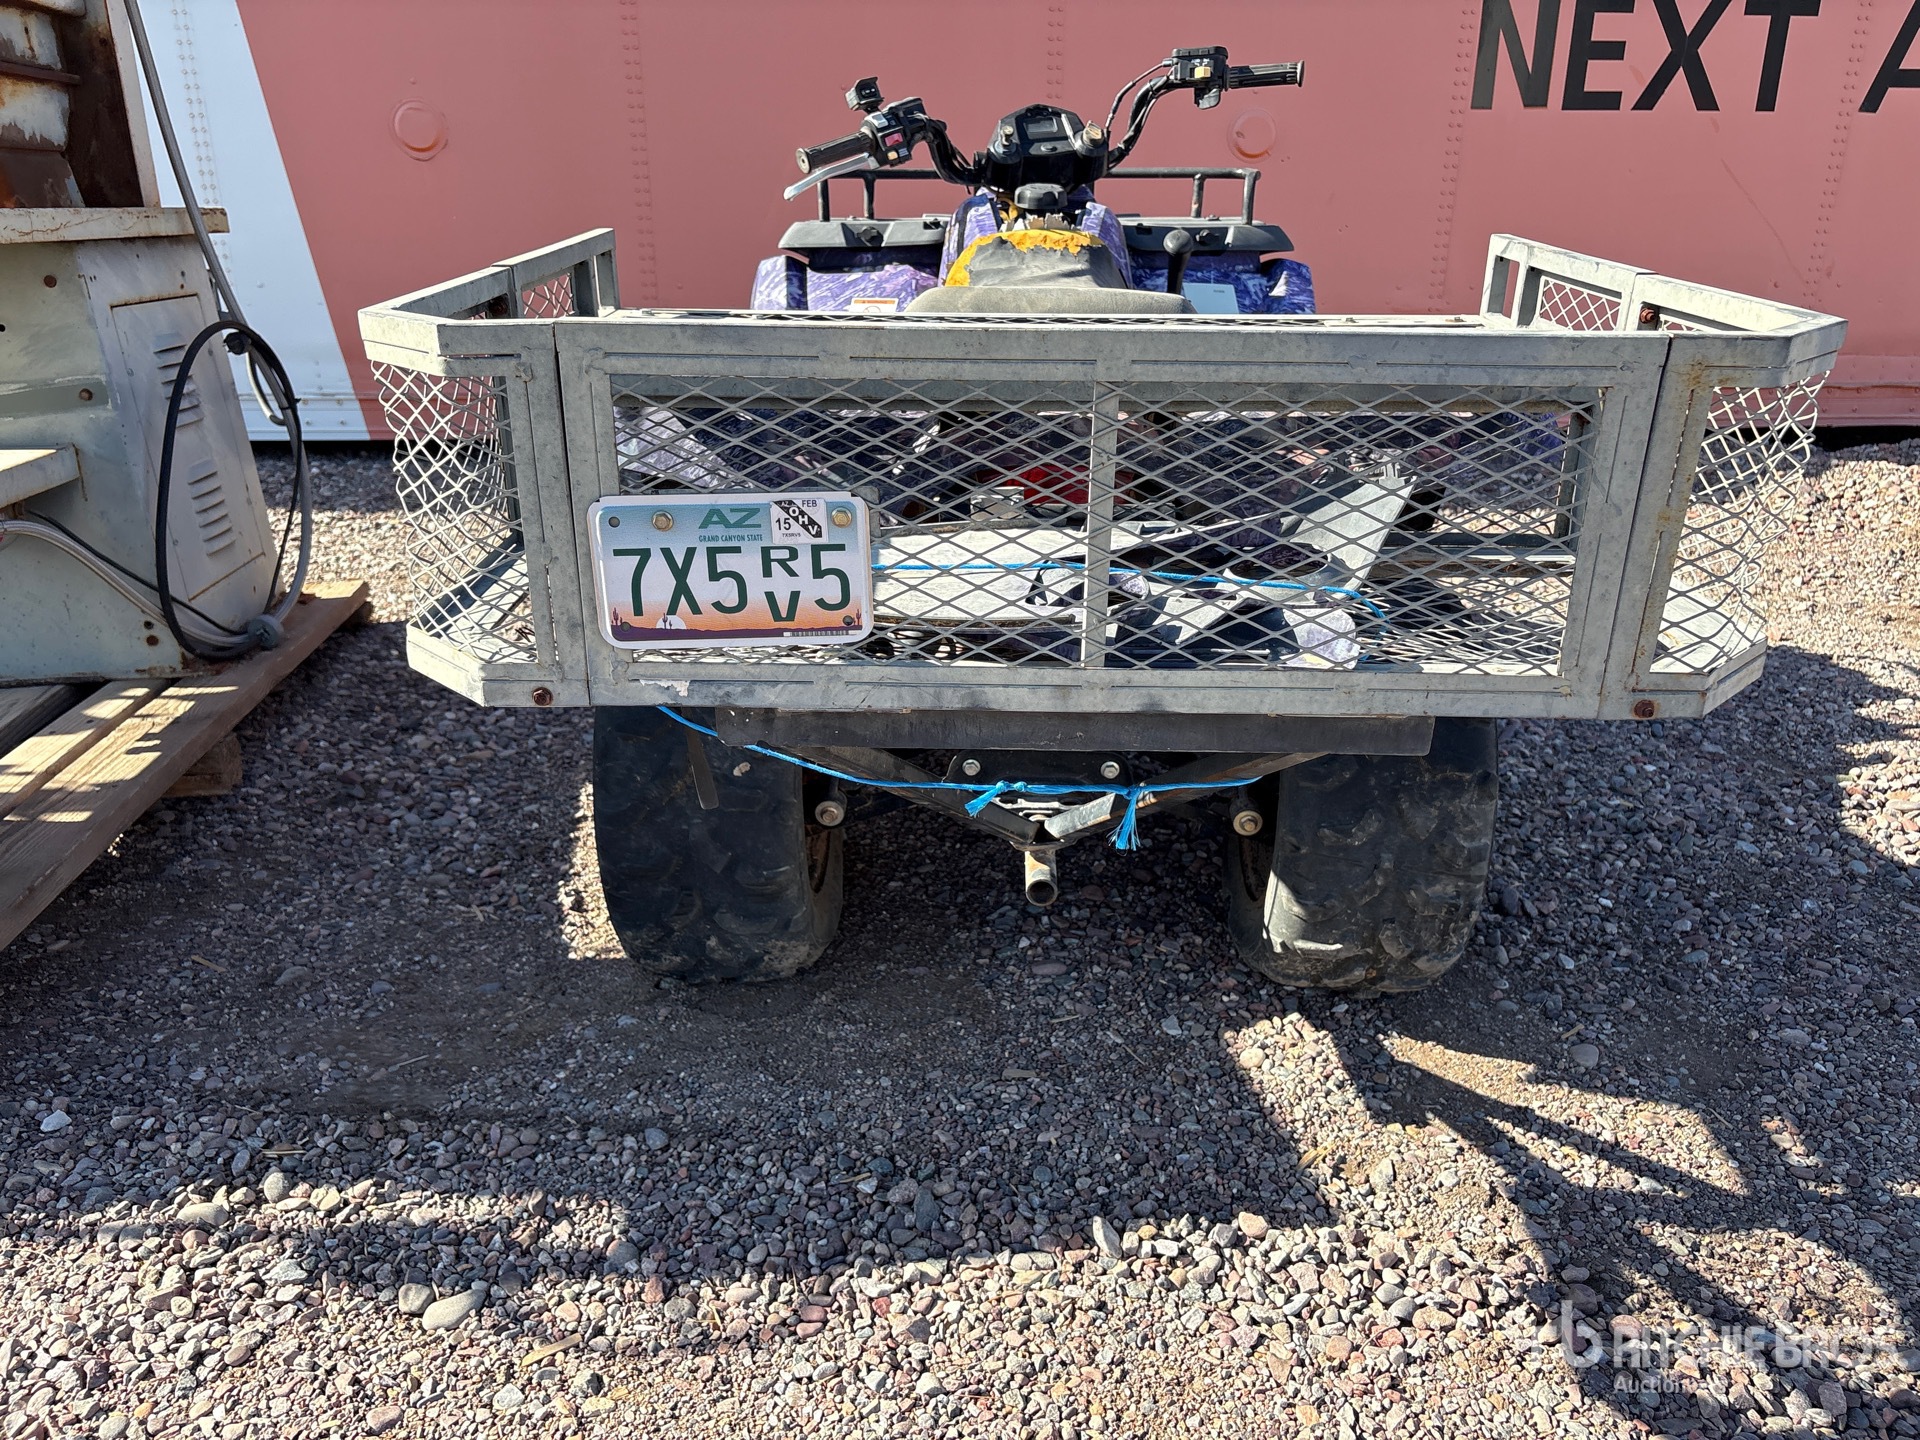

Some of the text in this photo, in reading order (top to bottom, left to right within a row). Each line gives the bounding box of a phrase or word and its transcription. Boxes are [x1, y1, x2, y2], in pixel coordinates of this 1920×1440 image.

[1470, 0, 1821, 112] NEXT
[801, 499, 818, 508] FEB
[698, 508, 762, 529] AZ
[775, 517, 791, 531] 15
[699, 534, 720, 542] GRAND
